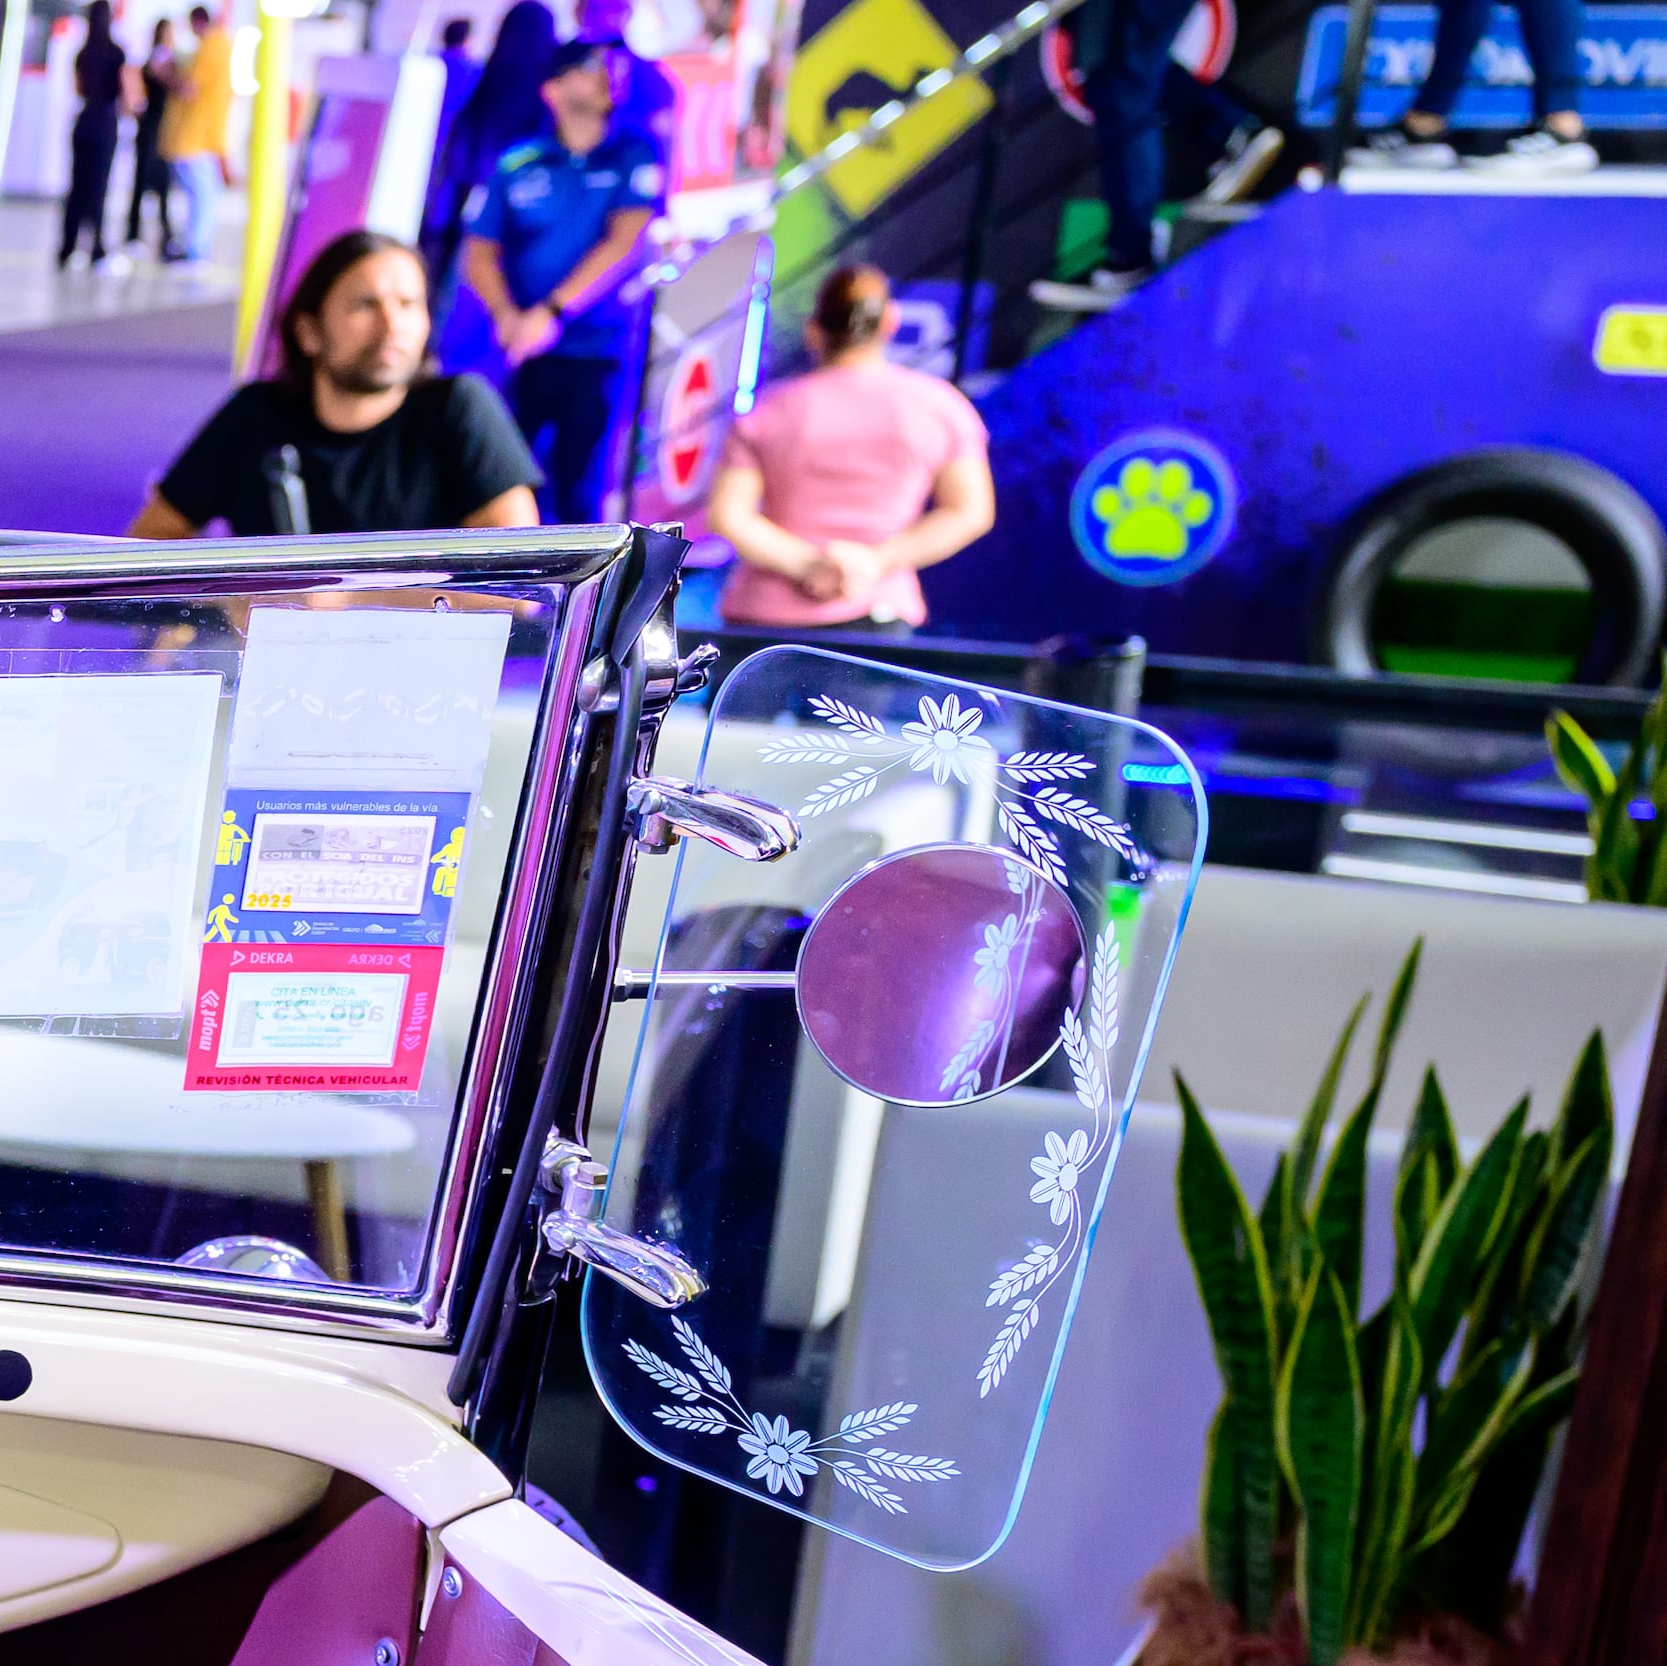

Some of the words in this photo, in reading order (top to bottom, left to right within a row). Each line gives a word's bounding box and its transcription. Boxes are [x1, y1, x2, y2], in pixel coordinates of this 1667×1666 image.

[256, 800, 302, 811] Usuarios
[305, 801, 327, 811] más
[330, 801, 391, 812] vulnerables
[393, 803, 407, 812] de
[410, 803, 419, 812] la
[262, 851, 292, 860] CON
[300, 851, 316, 860] EL
[322, 852, 353, 862] SOA
[359, 853, 385, 863] DEL
[391, 854, 415, 864] INS
[246, 893, 292, 908] 2025
[250, 952, 294, 964] DEKRA
[271, 987, 298, 997] CITA
[301, 987, 318, 997] EN
[321, 985, 356, 997] LÍNEA
[199, 1008, 217, 1051] mopt
[196, 1075, 260, 1085] REVISIÓN
[267, 1074, 324, 1085] TÉCNICA
[330, 1075, 408, 1085] VEHICULAR
